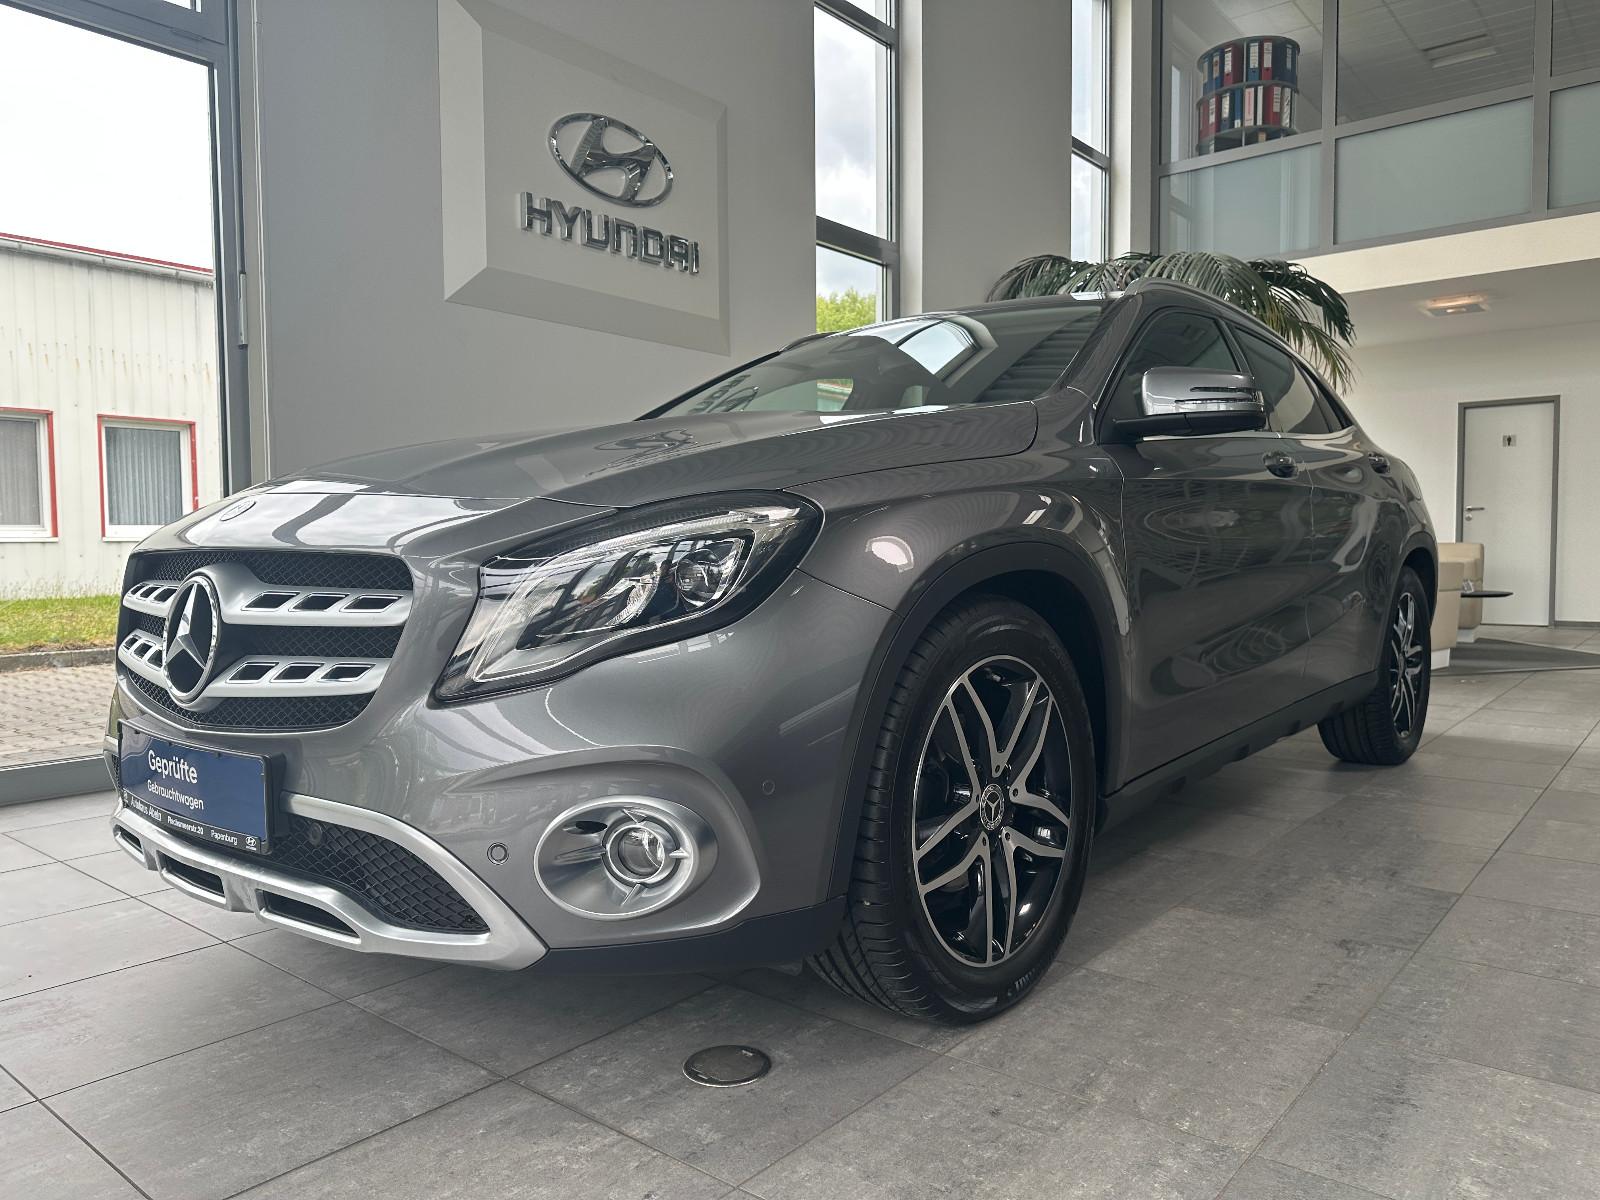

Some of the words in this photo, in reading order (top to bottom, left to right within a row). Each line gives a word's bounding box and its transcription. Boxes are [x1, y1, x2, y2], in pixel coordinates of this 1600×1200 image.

[519, 191, 700, 274] HYUNDAI
[148, 750, 198, 783] Geprüfte
[147, 780, 204, 810] Gebrauchtwagen
